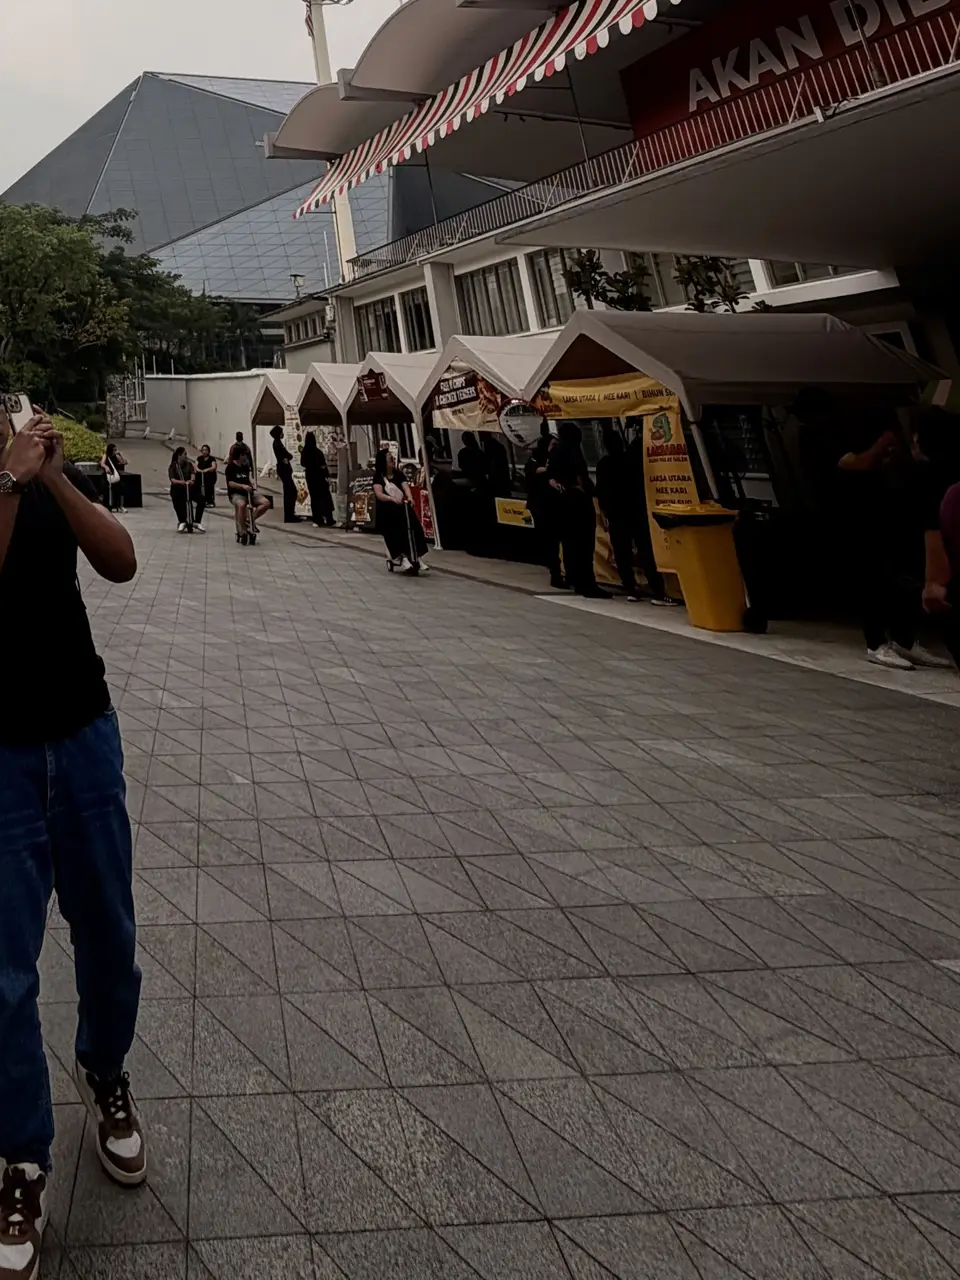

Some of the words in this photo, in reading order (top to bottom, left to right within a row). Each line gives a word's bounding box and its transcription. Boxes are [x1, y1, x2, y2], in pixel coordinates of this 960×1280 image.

[688, 15, 824, 113] AKAN
[562, 395, 579, 403] LAKSA
[616, 391, 631, 400] KARI
[641, 388, 665, 398] BIHUN
[649, 474, 667, 482] LAKSA
[668, 474, 693, 482] UTARA
[655, 486, 670, 494] MEE
[670, 486, 688, 494] KARI
